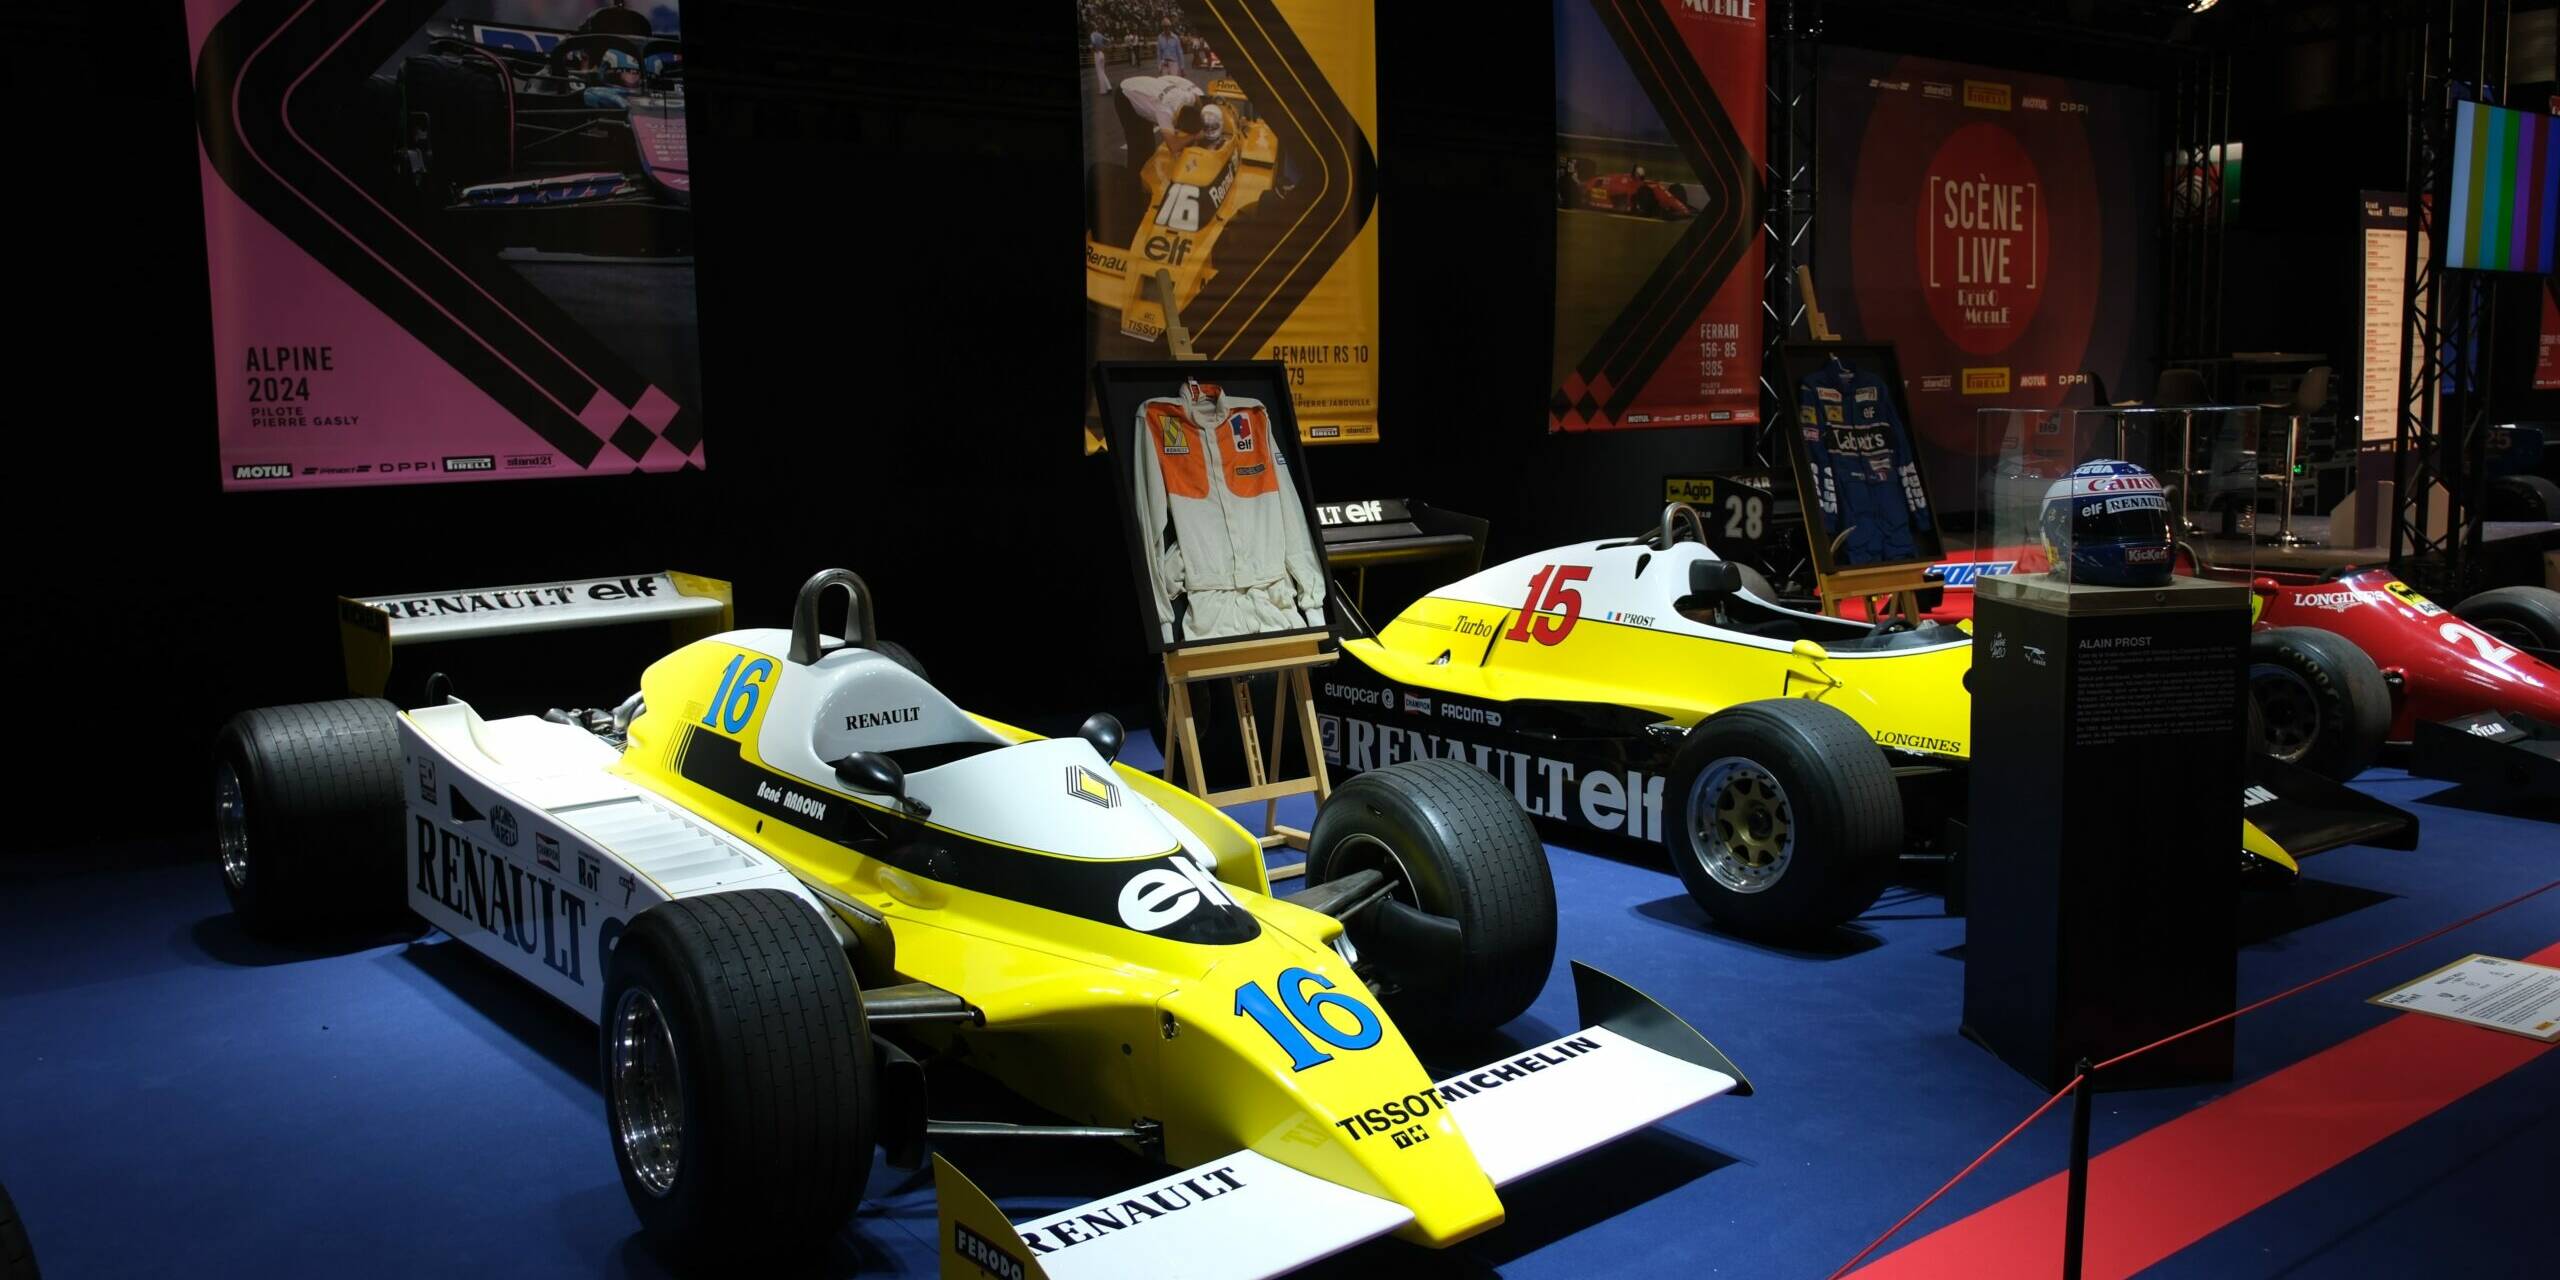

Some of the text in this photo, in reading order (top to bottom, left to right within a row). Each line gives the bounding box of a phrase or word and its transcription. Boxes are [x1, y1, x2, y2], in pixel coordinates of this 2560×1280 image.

[2060, 102, 2089, 114] DPPI
[1154, 183, 1200, 232] 16
[1944, 173, 2024, 231] SCÈNE
[1087, 246, 1127, 273] Renau
[1144, 236, 1193, 267] elf
[1958, 236, 2011, 284] LIVE
[1700, 323, 1739, 340] FERRARI
[246, 346, 334, 372] ALPINE
[1273, 345, 1369, 364] RENAULT RS 10
[1724, 342, 1737, 358] 85
[1288, 367, 1305, 386] 79
[1701, 360, 1723, 376] 1985
[248, 376, 310, 402] 2024
[2020, 375, 2047, 387] MOTUL
[2058, 373, 2088, 386] DPPI
[251, 406, 304, 418] PILOTE
[252, 415, 360, 428] PIERRE GASLY
[1237, 438, 1251, 450] elf
[236, 465, 292, 479] MOTUL
[380, 462, 435, 473] DPPI
[1684, 482, 1711, 500] Agip
[1345, 499, 1383, 524] elf
[1724, 495, 1764, 540] 28
[2081, 502, 2103, 517] elf
[588, 577, 658, 600] elf
[1505, 565, 1593, 647] 15
[1454, 615, 1492, 638] Turbo
[1623, 613, 1656, 627] PROST
[2079, 635, 2152, 649] ALAIN PROST
[702, 654, 774, 734] 16
[1324, 682, 1380, 705] europcar
[845, 706, 921, 731] RENAULT
[1441, 703, 1484, 724] FACOM
[1875, 730, 1961, 754] LONGINES
[757, 781, 783, 804] René
[1579, 768, 1666, 844] elf
[416, 814, 587, 987] RENAULT
[1234, 967, 1383, 1073] 16
[1439, 1037, 1603, 1105] MICHELIN
[1336, 1087, 1445, 1141] TISSOT
[1021, 1166, 1248, 1257] RENAULT
[957, 1227, 1024, 1280] FERODO
